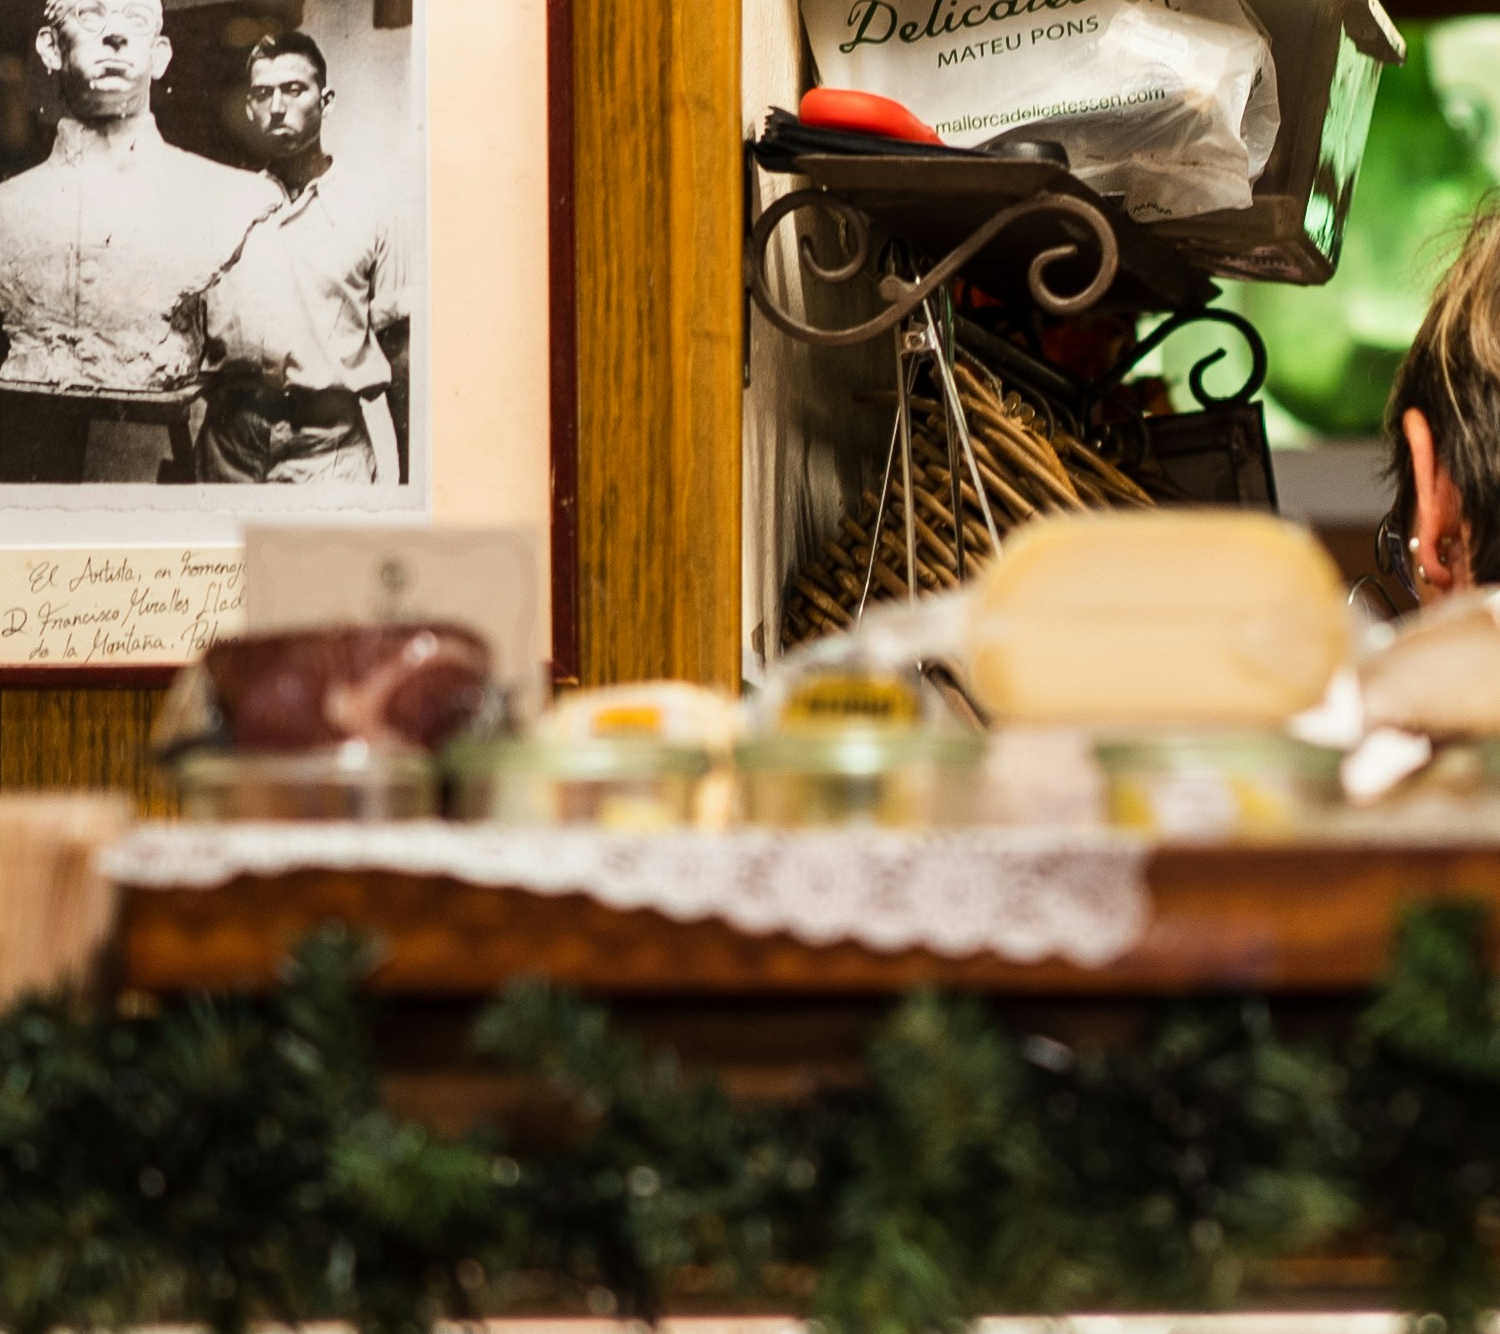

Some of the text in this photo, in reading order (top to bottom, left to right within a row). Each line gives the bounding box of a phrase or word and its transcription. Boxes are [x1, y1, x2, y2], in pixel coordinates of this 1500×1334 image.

[937, 14, 1100, 69] MATEU PONS
[935, 85, 1166, 135] mallorcadelicatessen.com
[29, 560, 60, 594] El
[154, 567, 172, 580] en
[37, 600, 120, 637] Francisco
[195, 580, 246, 621] Llad
[28, 637, 50, 661] de
[62, 632, 79, 660] la
